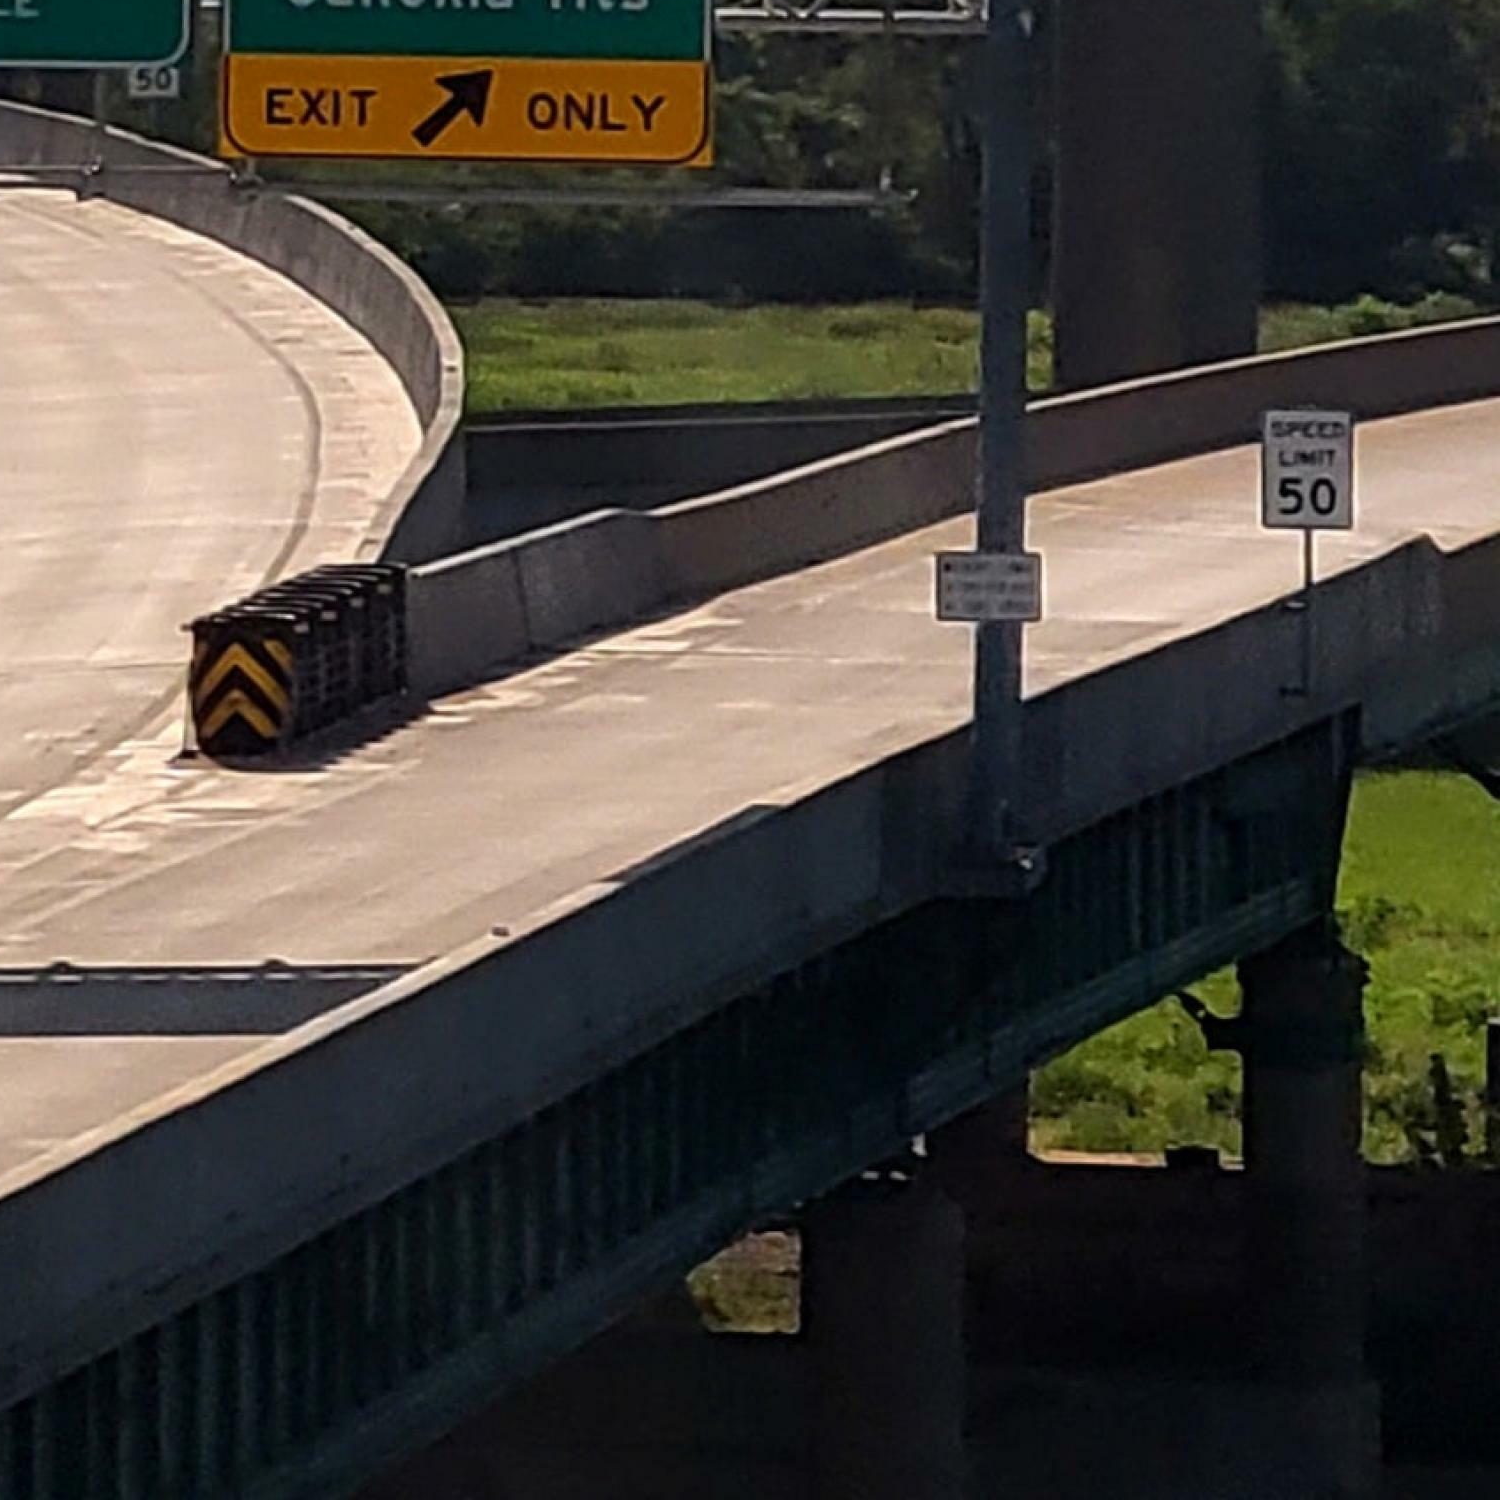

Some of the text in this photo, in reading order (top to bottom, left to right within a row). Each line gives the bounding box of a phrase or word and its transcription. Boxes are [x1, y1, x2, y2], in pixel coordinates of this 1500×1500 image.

[135, 66, 172, 92] 50
[265, 89, 666, 132] EXIT ONLY
[1269, 420, 1347, 440] SPEED
[1278, 448, 1337, 469] LIMIT
[1278, 476, 1338, 516] 50
